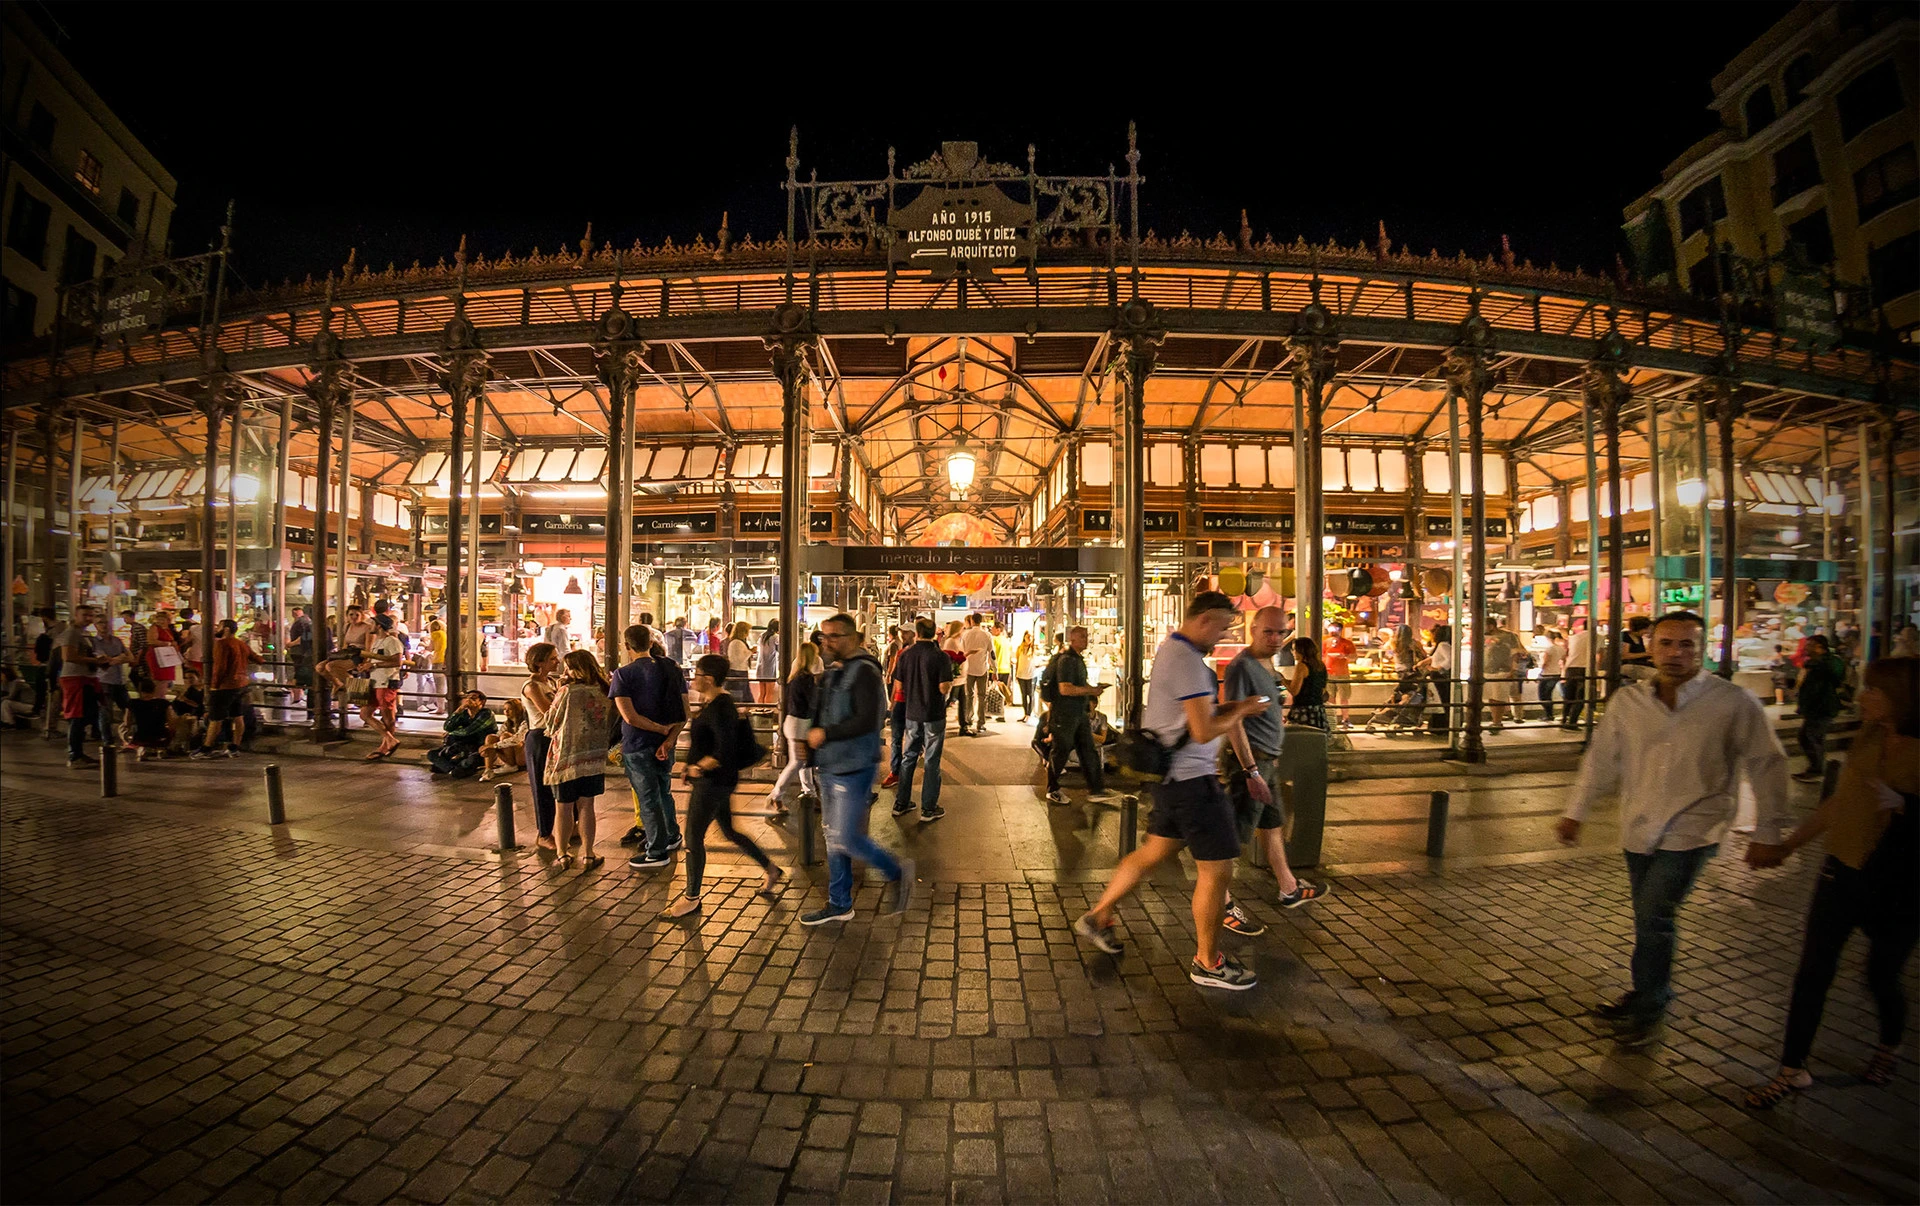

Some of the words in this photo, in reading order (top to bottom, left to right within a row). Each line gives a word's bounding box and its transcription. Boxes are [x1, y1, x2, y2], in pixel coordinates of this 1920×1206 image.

[932, 210, 956, 225] AÑO
[964, 210, 991, 224] 1915
[907, 229, 952, 243] ALFONSO
[955, 225, 981, 241] DUBÉ
[984, 228, 991, 240] Y
[994, 225, 1016, 241] DÍEZ
[1225, 518, 1272, 528] Cacharrería
[880, 550, 941, 564] mercado
[947, 550, 961, 564] de
[994, 551, 1041, 568] miguel
